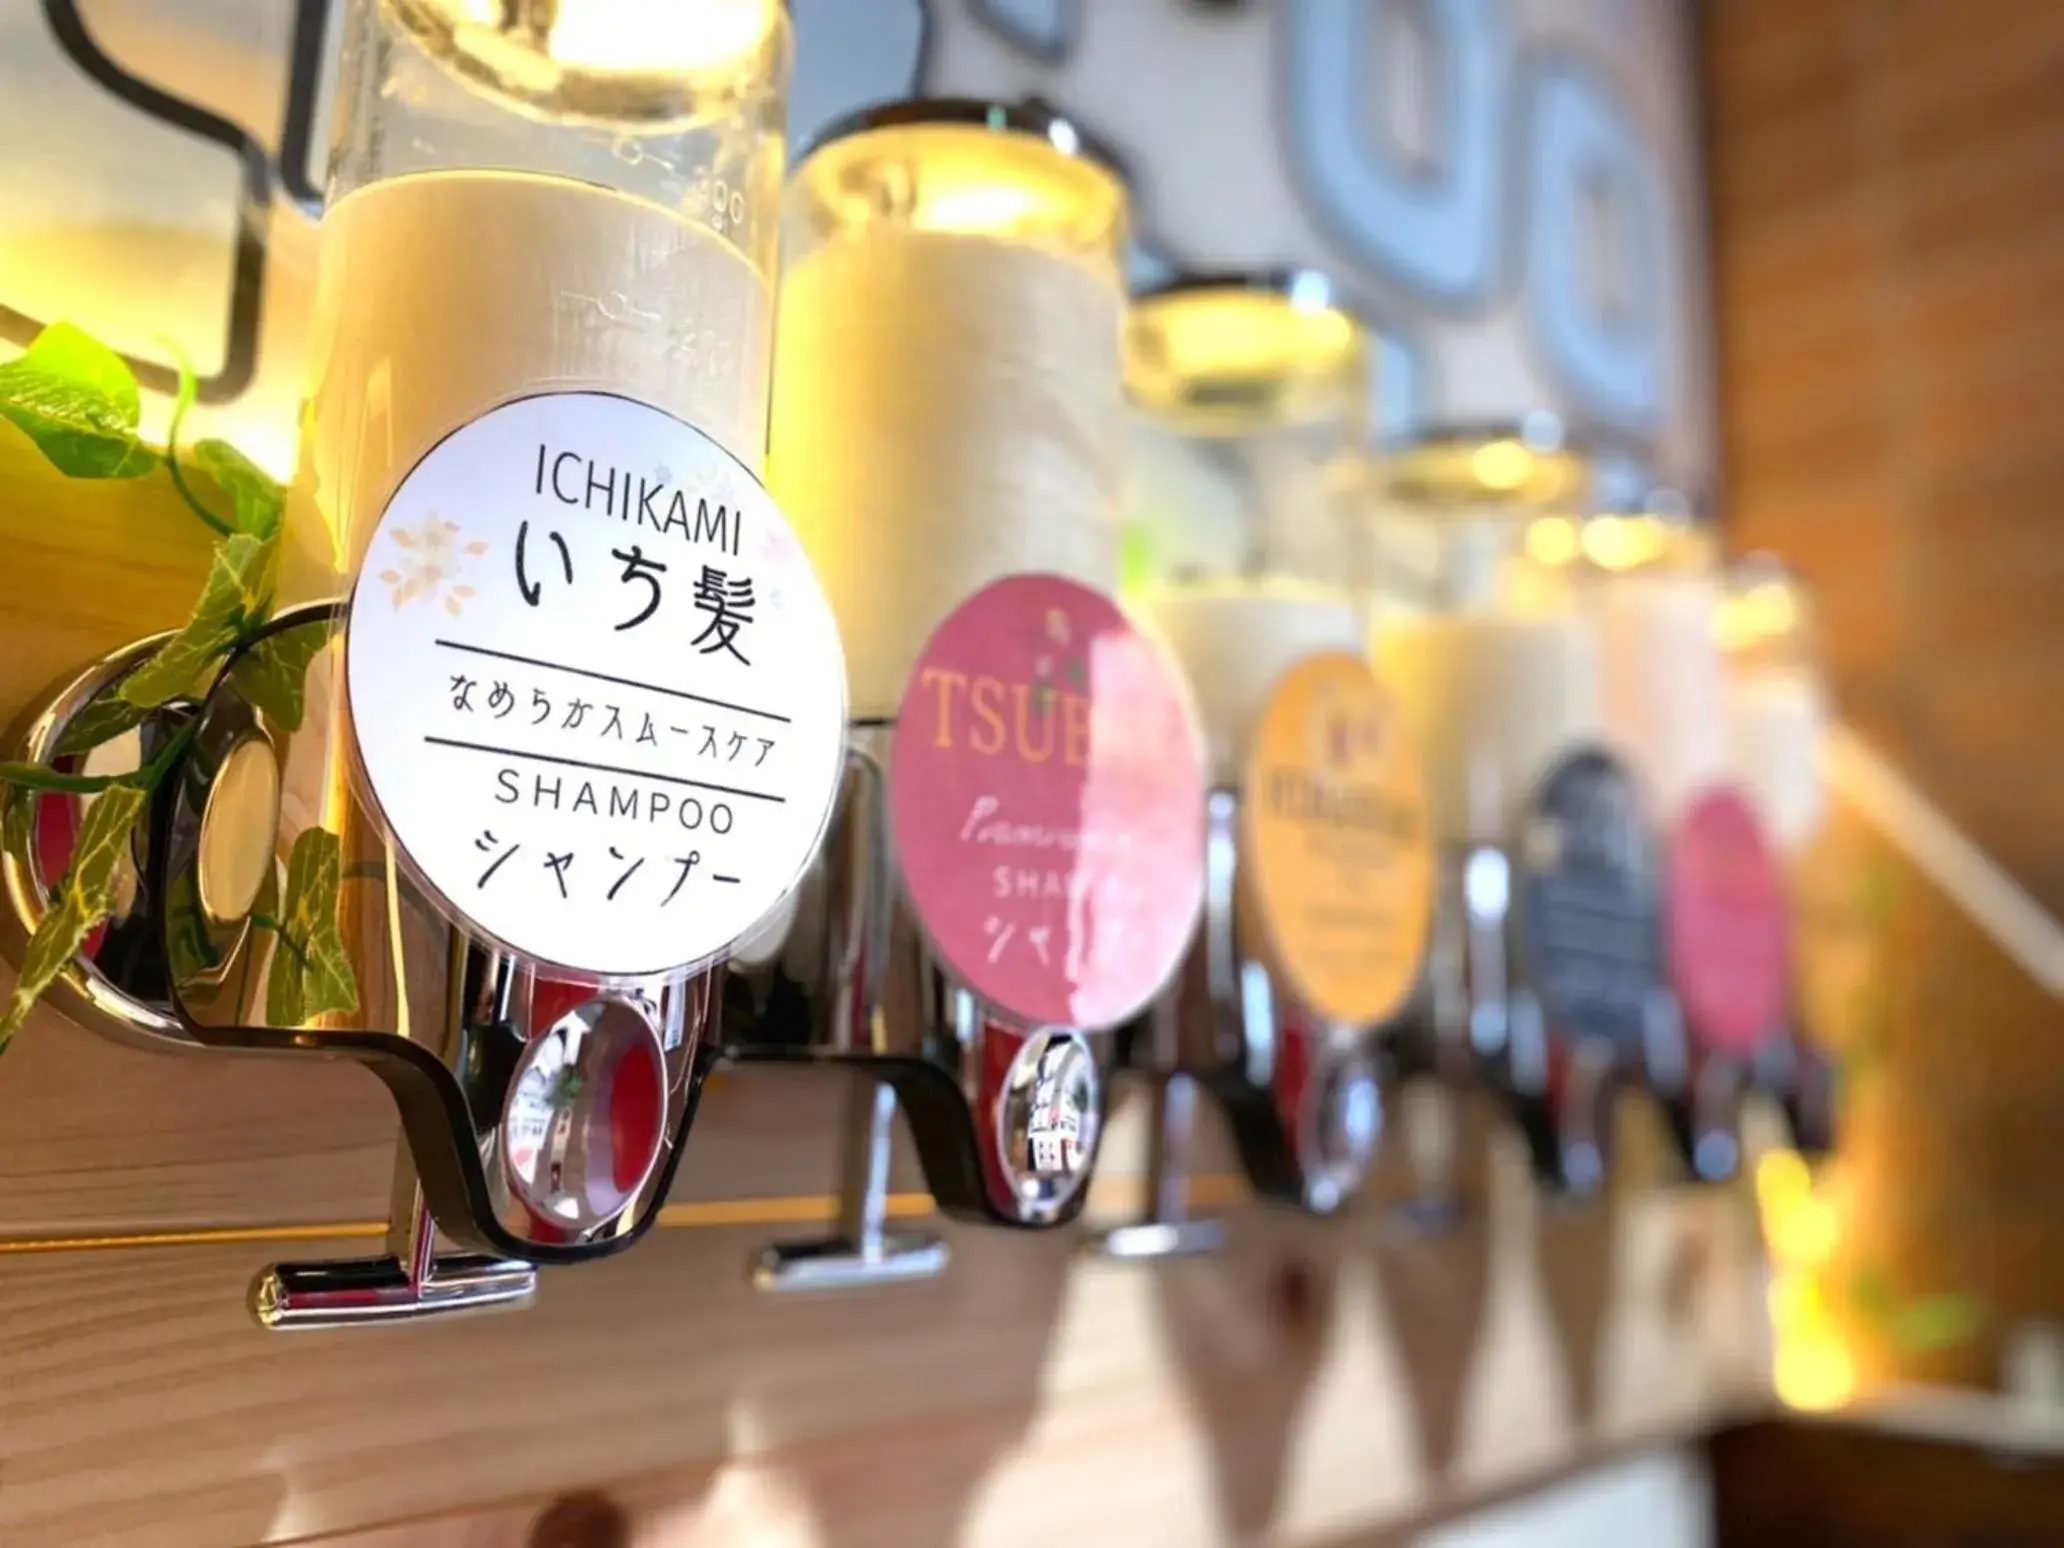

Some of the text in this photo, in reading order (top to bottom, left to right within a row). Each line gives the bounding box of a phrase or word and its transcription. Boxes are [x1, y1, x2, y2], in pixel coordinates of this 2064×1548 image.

[536, 443, 741, 557] ICHIKAMI
[514, 520, 757, 667] いち髪
[450, 674, 776, 768] なめらかスムースケア
[495, 769, 735, 835] SHAMPOO
[475, 829, 742, 907] シャンプー
